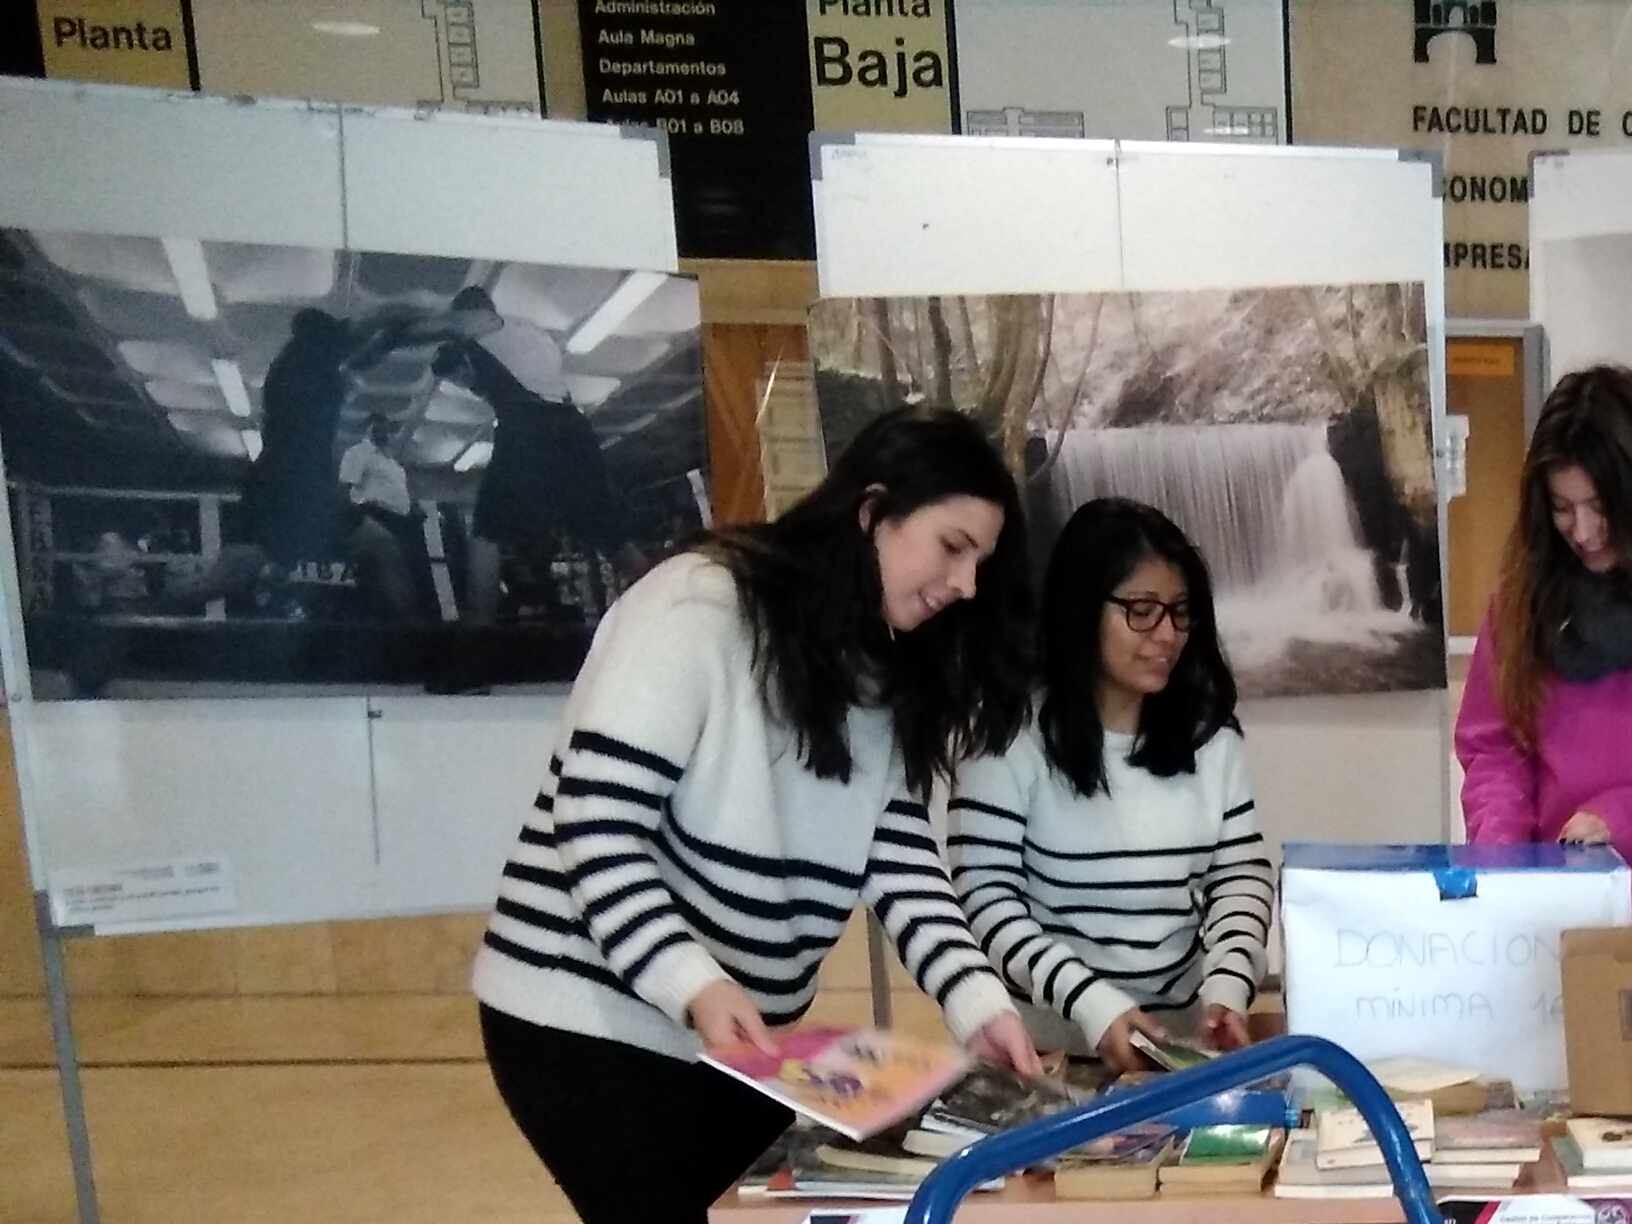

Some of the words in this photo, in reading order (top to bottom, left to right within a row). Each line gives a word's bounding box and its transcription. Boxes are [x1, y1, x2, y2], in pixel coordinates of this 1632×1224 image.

[53, 16, 173, 51] Planta
[599, 29, 634, 45] Aula
[640, 28, 695, 48] Magna
[599, 58, 727, 76] Departamentos
[814, 35, 943, 98] Baja
[602, 88, 647, 104] Aulas
[654, 89, 684, 105] A01
[689, 92, 701, 105] a
[707, 89, 740, 106] A04
[1412, 105, 1548, 136] FACULTAD
[1567, 110, 1601, 136] DE
[1443, 176, 1529, 203] ONOM
[1444, 243, 1529, 270] PRES
